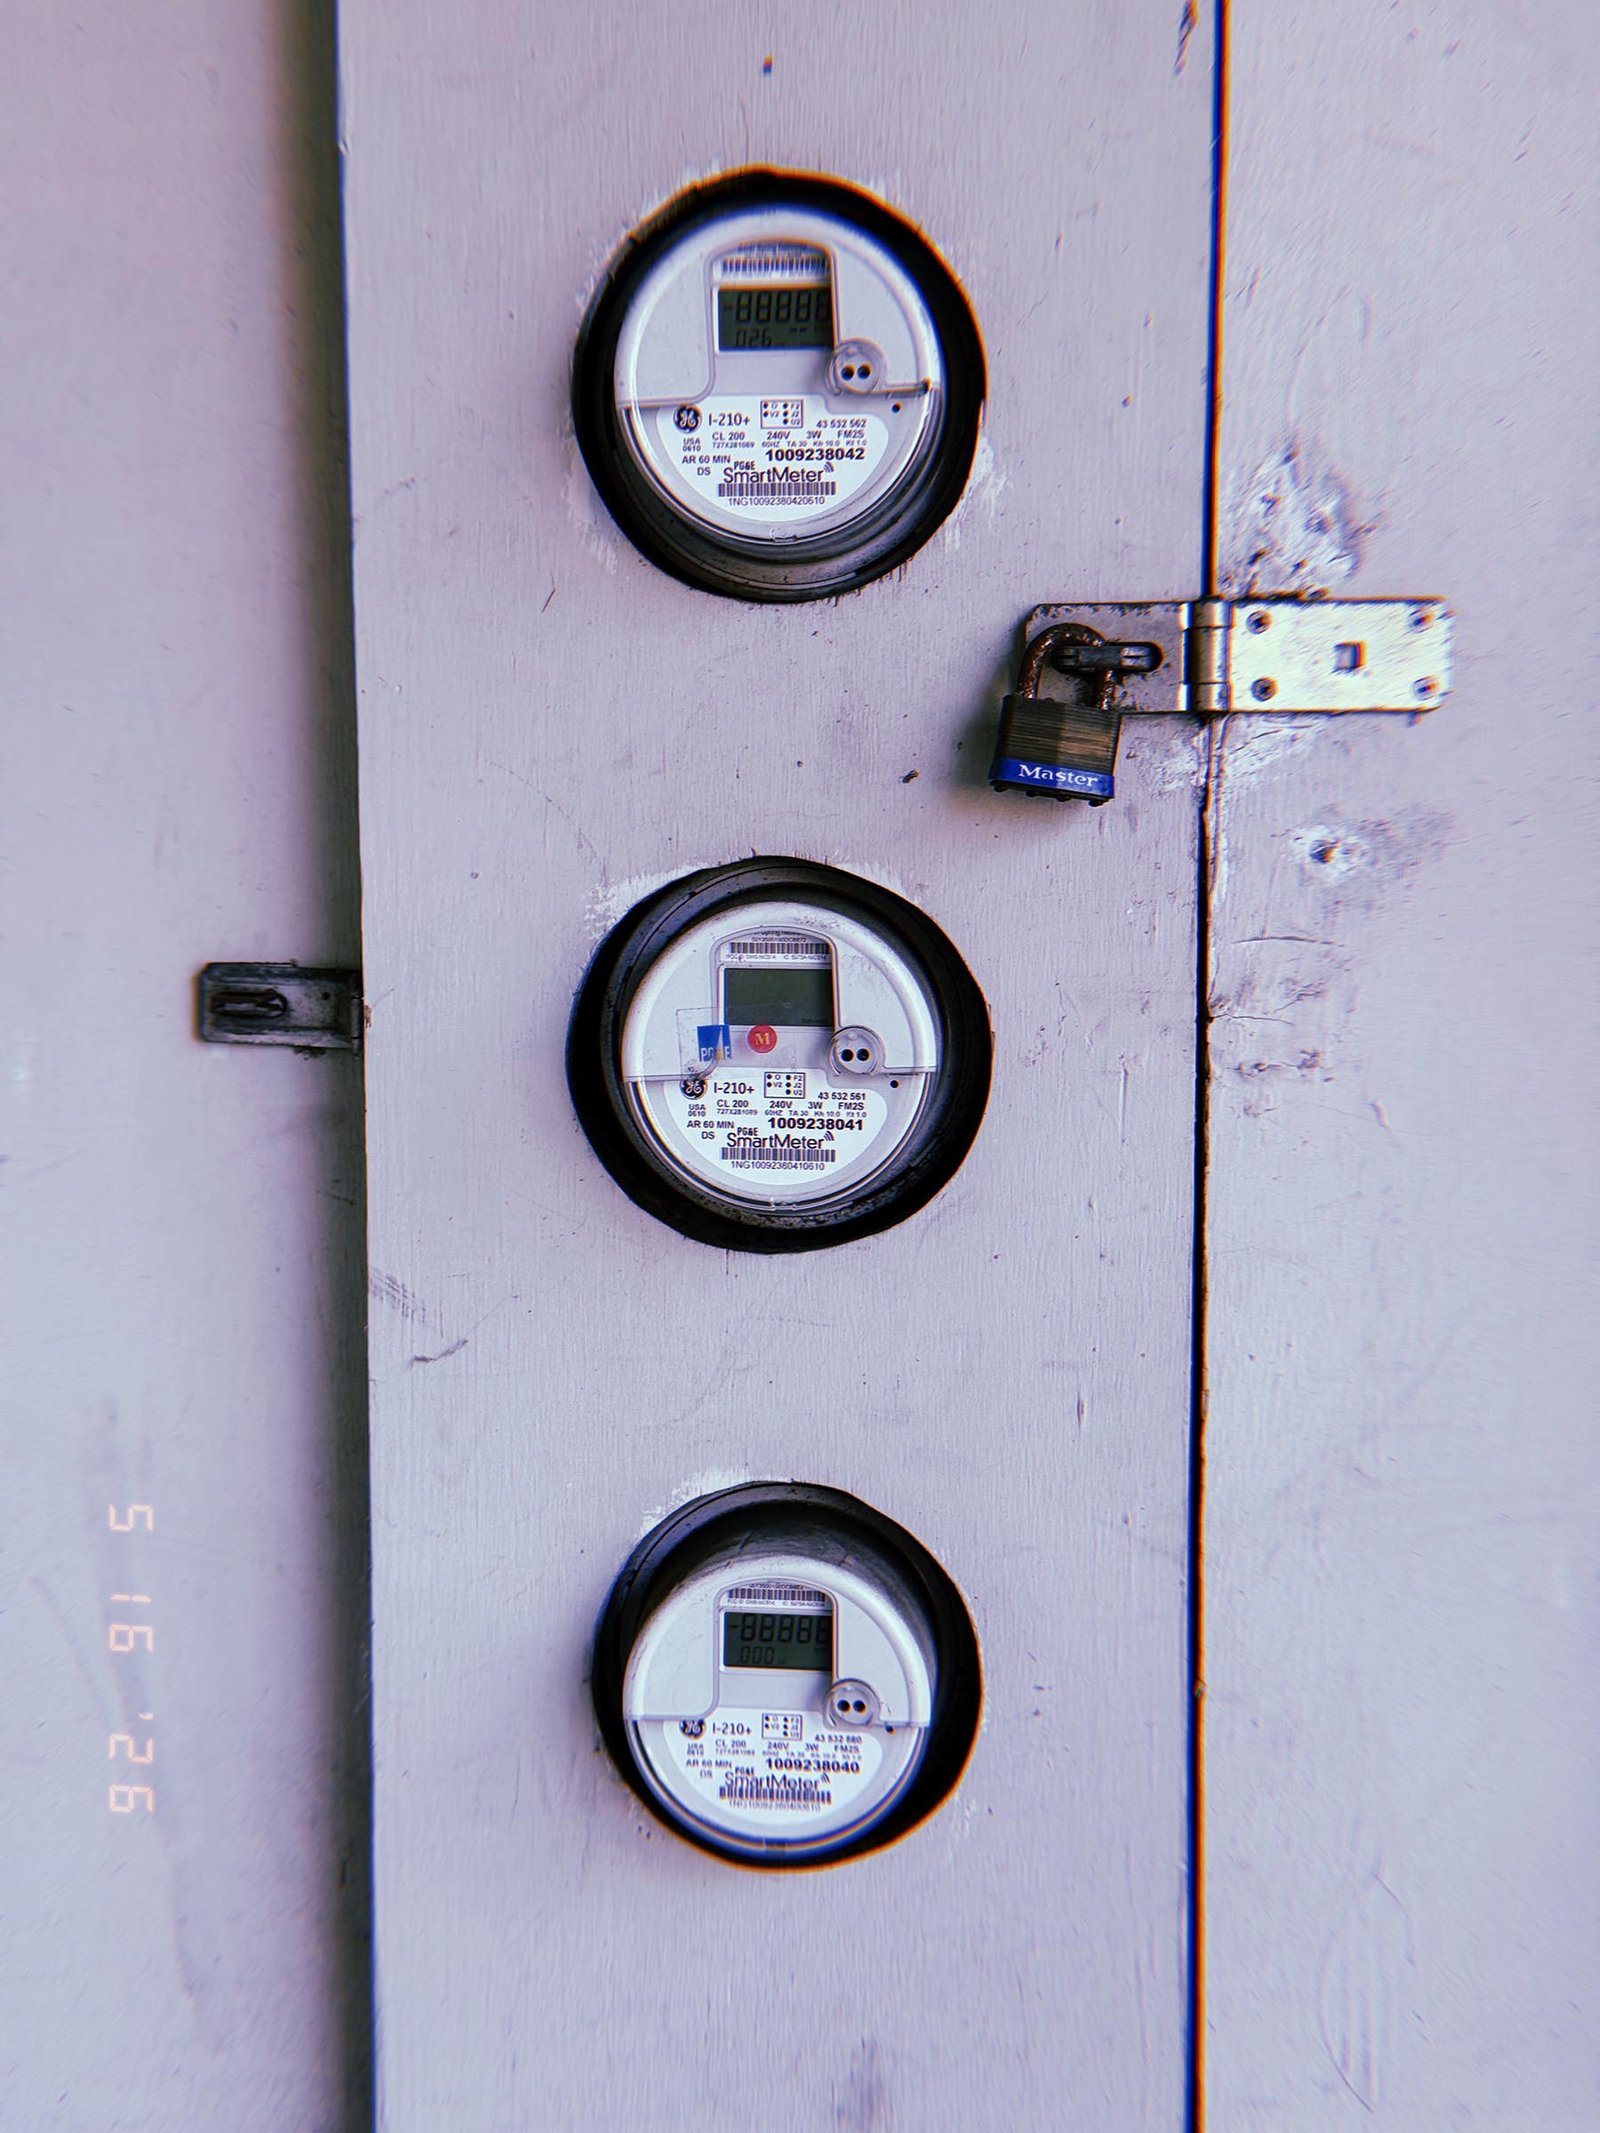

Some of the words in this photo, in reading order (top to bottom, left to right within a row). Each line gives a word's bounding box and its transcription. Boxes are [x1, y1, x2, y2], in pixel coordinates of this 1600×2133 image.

[708, 411, 750, 426] I-210+
[816, 419, 828, 428] 43
[830, 419, 847, 428] 532
[849, 418, 867, 428] 562
[712, 432, 725, 441] CL
[728, 431, 746, 441] 200
[766, 430, 790, 440] 240V
[806, 430, 822, 440] 3W
[837, 429, 864, 439] FM2S
[682, 455, 696, 464] AR
[698, 455, 710, 464] 60
[712, 455, 731, 464] MIN
[765, 447, 865, 461] 1009238042
[733, 460, 756, 470] PG&E
[697, 467, 711, 476] DS
[723, 466, 824, 483] SmartMeter
[1018, 764, 1098, 787] Master
[754, 1031, 771, 1045] M
[713, 1081, 755, 1095] I-210+
[818, 1092, 829, 1100] 43
[831, 1092, 847, 1100] 532
[849, 1092, 866, 1100] 561
[716, 1100, 729, 1108] CL
[732, 1100, 749, 1108] 200
[769, 1100, 793, 1109] 240V
[807, 1101, 823, 1109] 3W
[838, 1102, 864, 1110] FM2S
[687, 1120, 701, 1128] AR
[703, 1120, 715, 1129] 60
[717, 1121, 735, 1129] MIN
[767, 1117, 864, 1131] 1009238041
[701, 1131, 715, 1139] DS
[737, 1127, 758, 1136] PG&E
[726, 1132, 824, 1149] SmartMeter
[713, 1722, 752, 1735] I-210+
[815, 1734, 825, 1742] 43
[715, 1739, 726, 1747] CL
[731, 1740, 747, 1748] 200
[767, 1741, 789, 1750] 240V
[805, 1743, 819, 1751] 3W
[715, 1759, 732, 1768] MIN
[765, 1758, 861, 1774] 1009238040
[725, 1771, 819, 1789] SmartMeter
